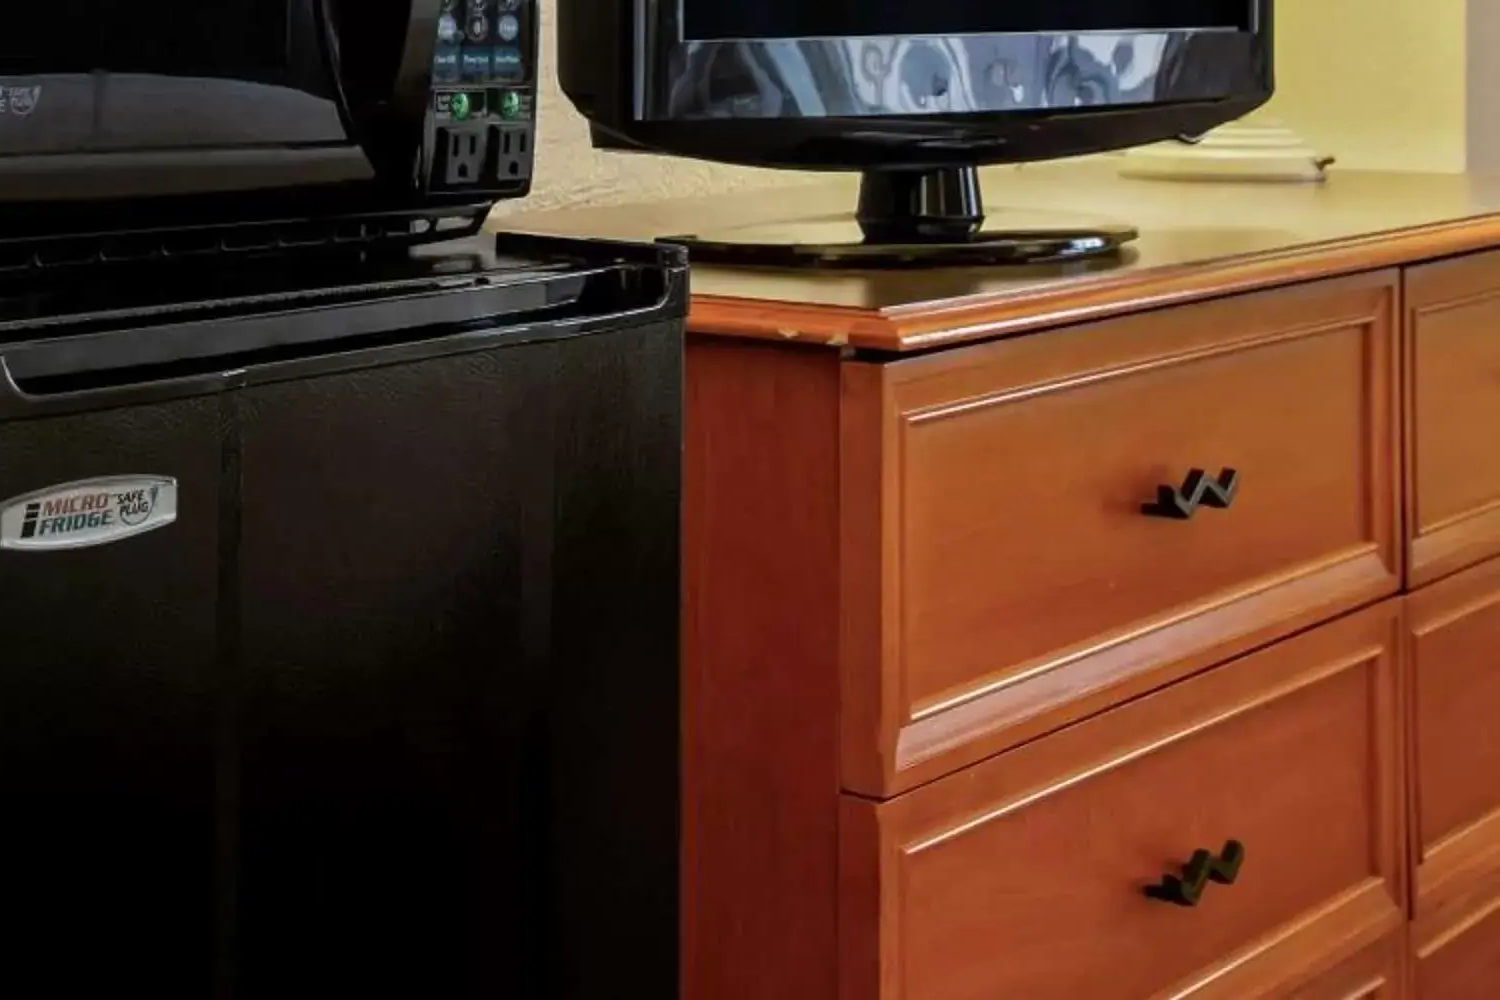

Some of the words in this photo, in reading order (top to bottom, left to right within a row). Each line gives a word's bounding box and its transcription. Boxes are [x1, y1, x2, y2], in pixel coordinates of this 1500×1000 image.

[43, 492, 109, 514] MICRO
[116, 489, 146, 505] SAFE
[119, 501, 150, 517] PLUG
[39, 511, 112, 535] FRIDGE
